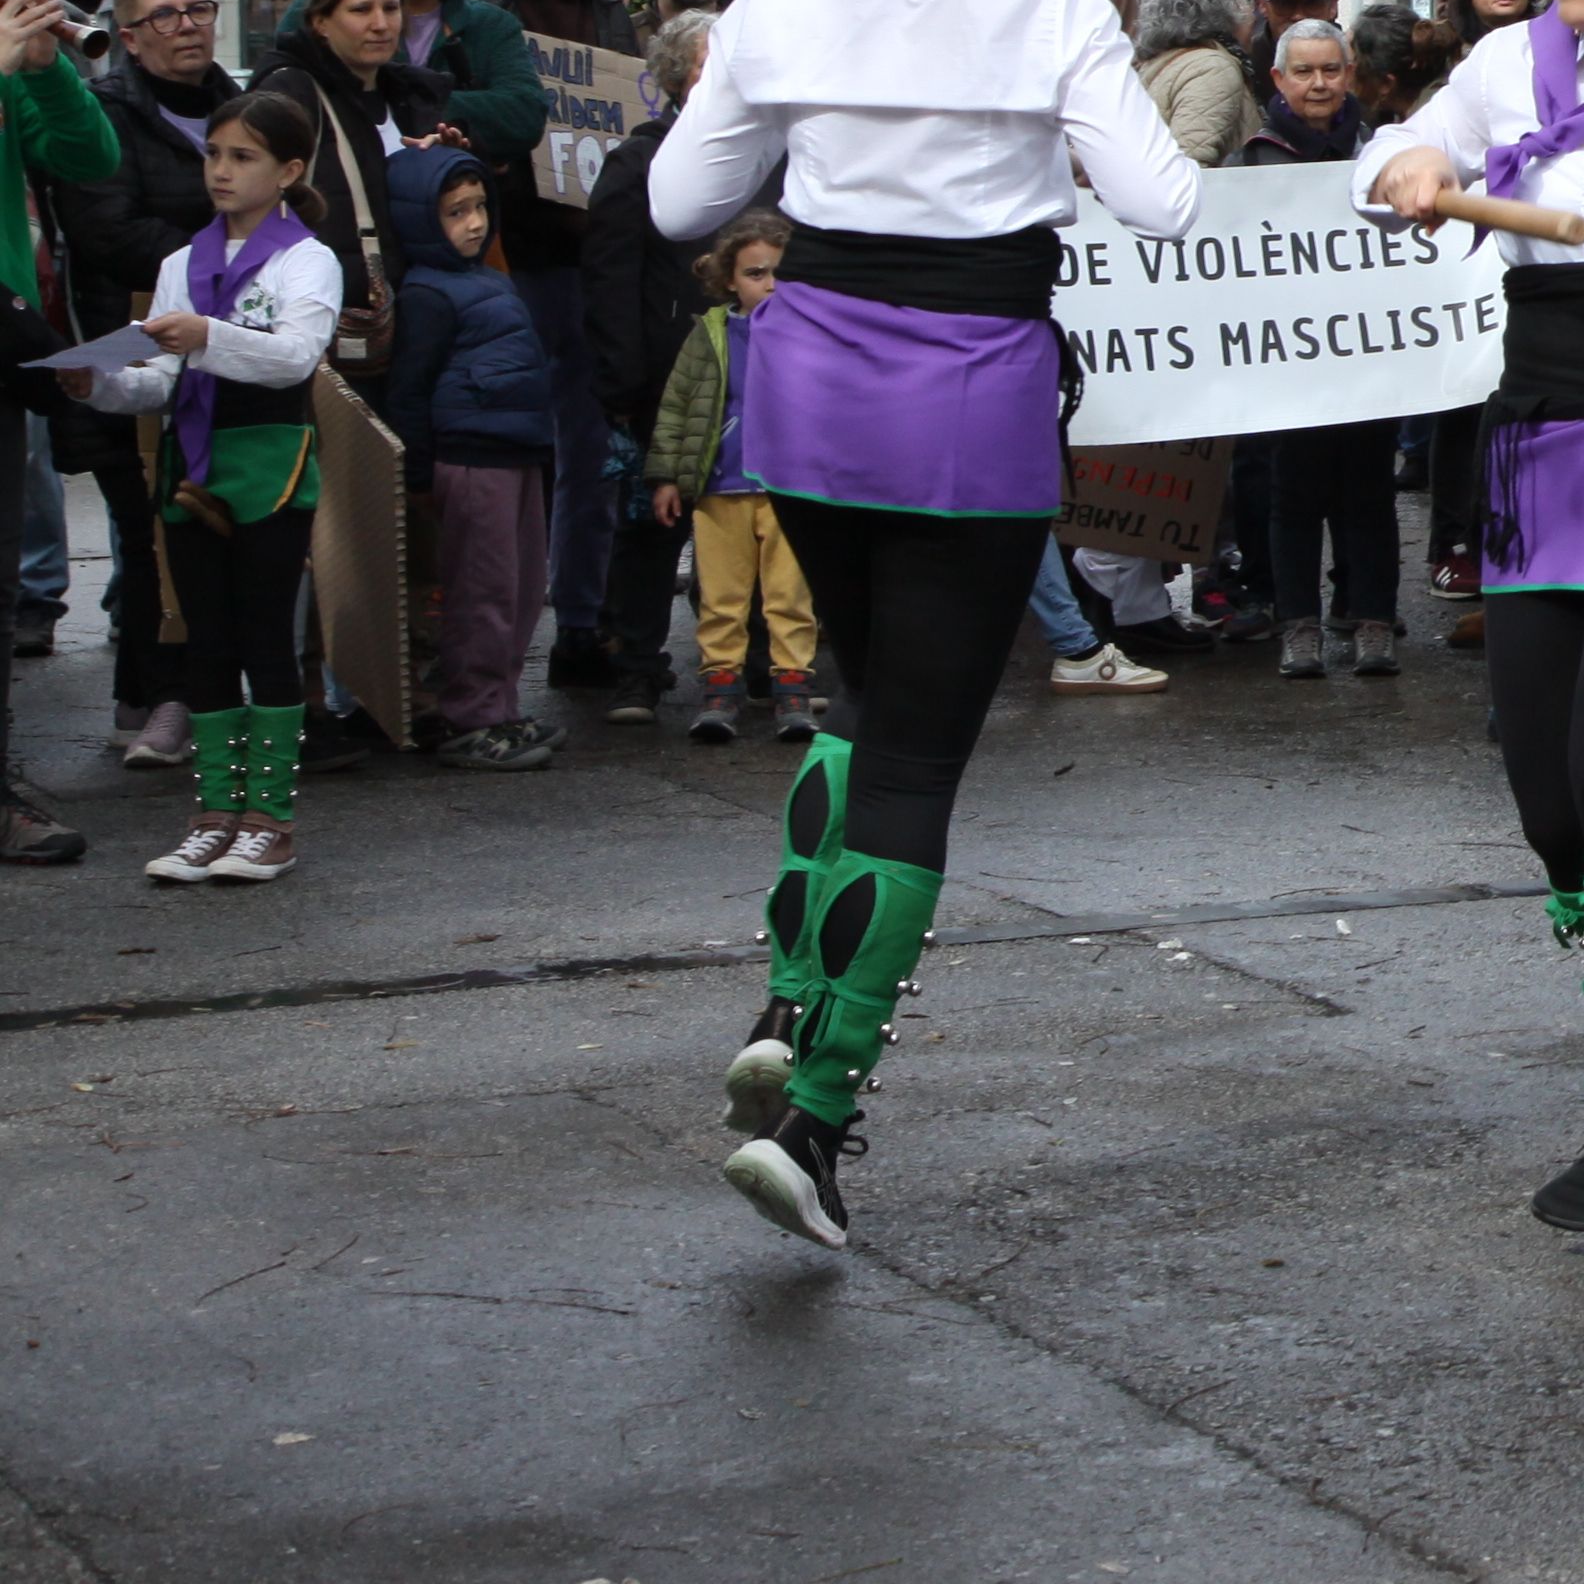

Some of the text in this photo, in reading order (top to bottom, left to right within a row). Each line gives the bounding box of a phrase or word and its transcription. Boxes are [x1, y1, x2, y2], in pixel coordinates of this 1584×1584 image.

[1055, 220, 1440, 288] DE VIOLÈNCIES
[1068, 292, 1500, 374] NATS MASCLISTE
